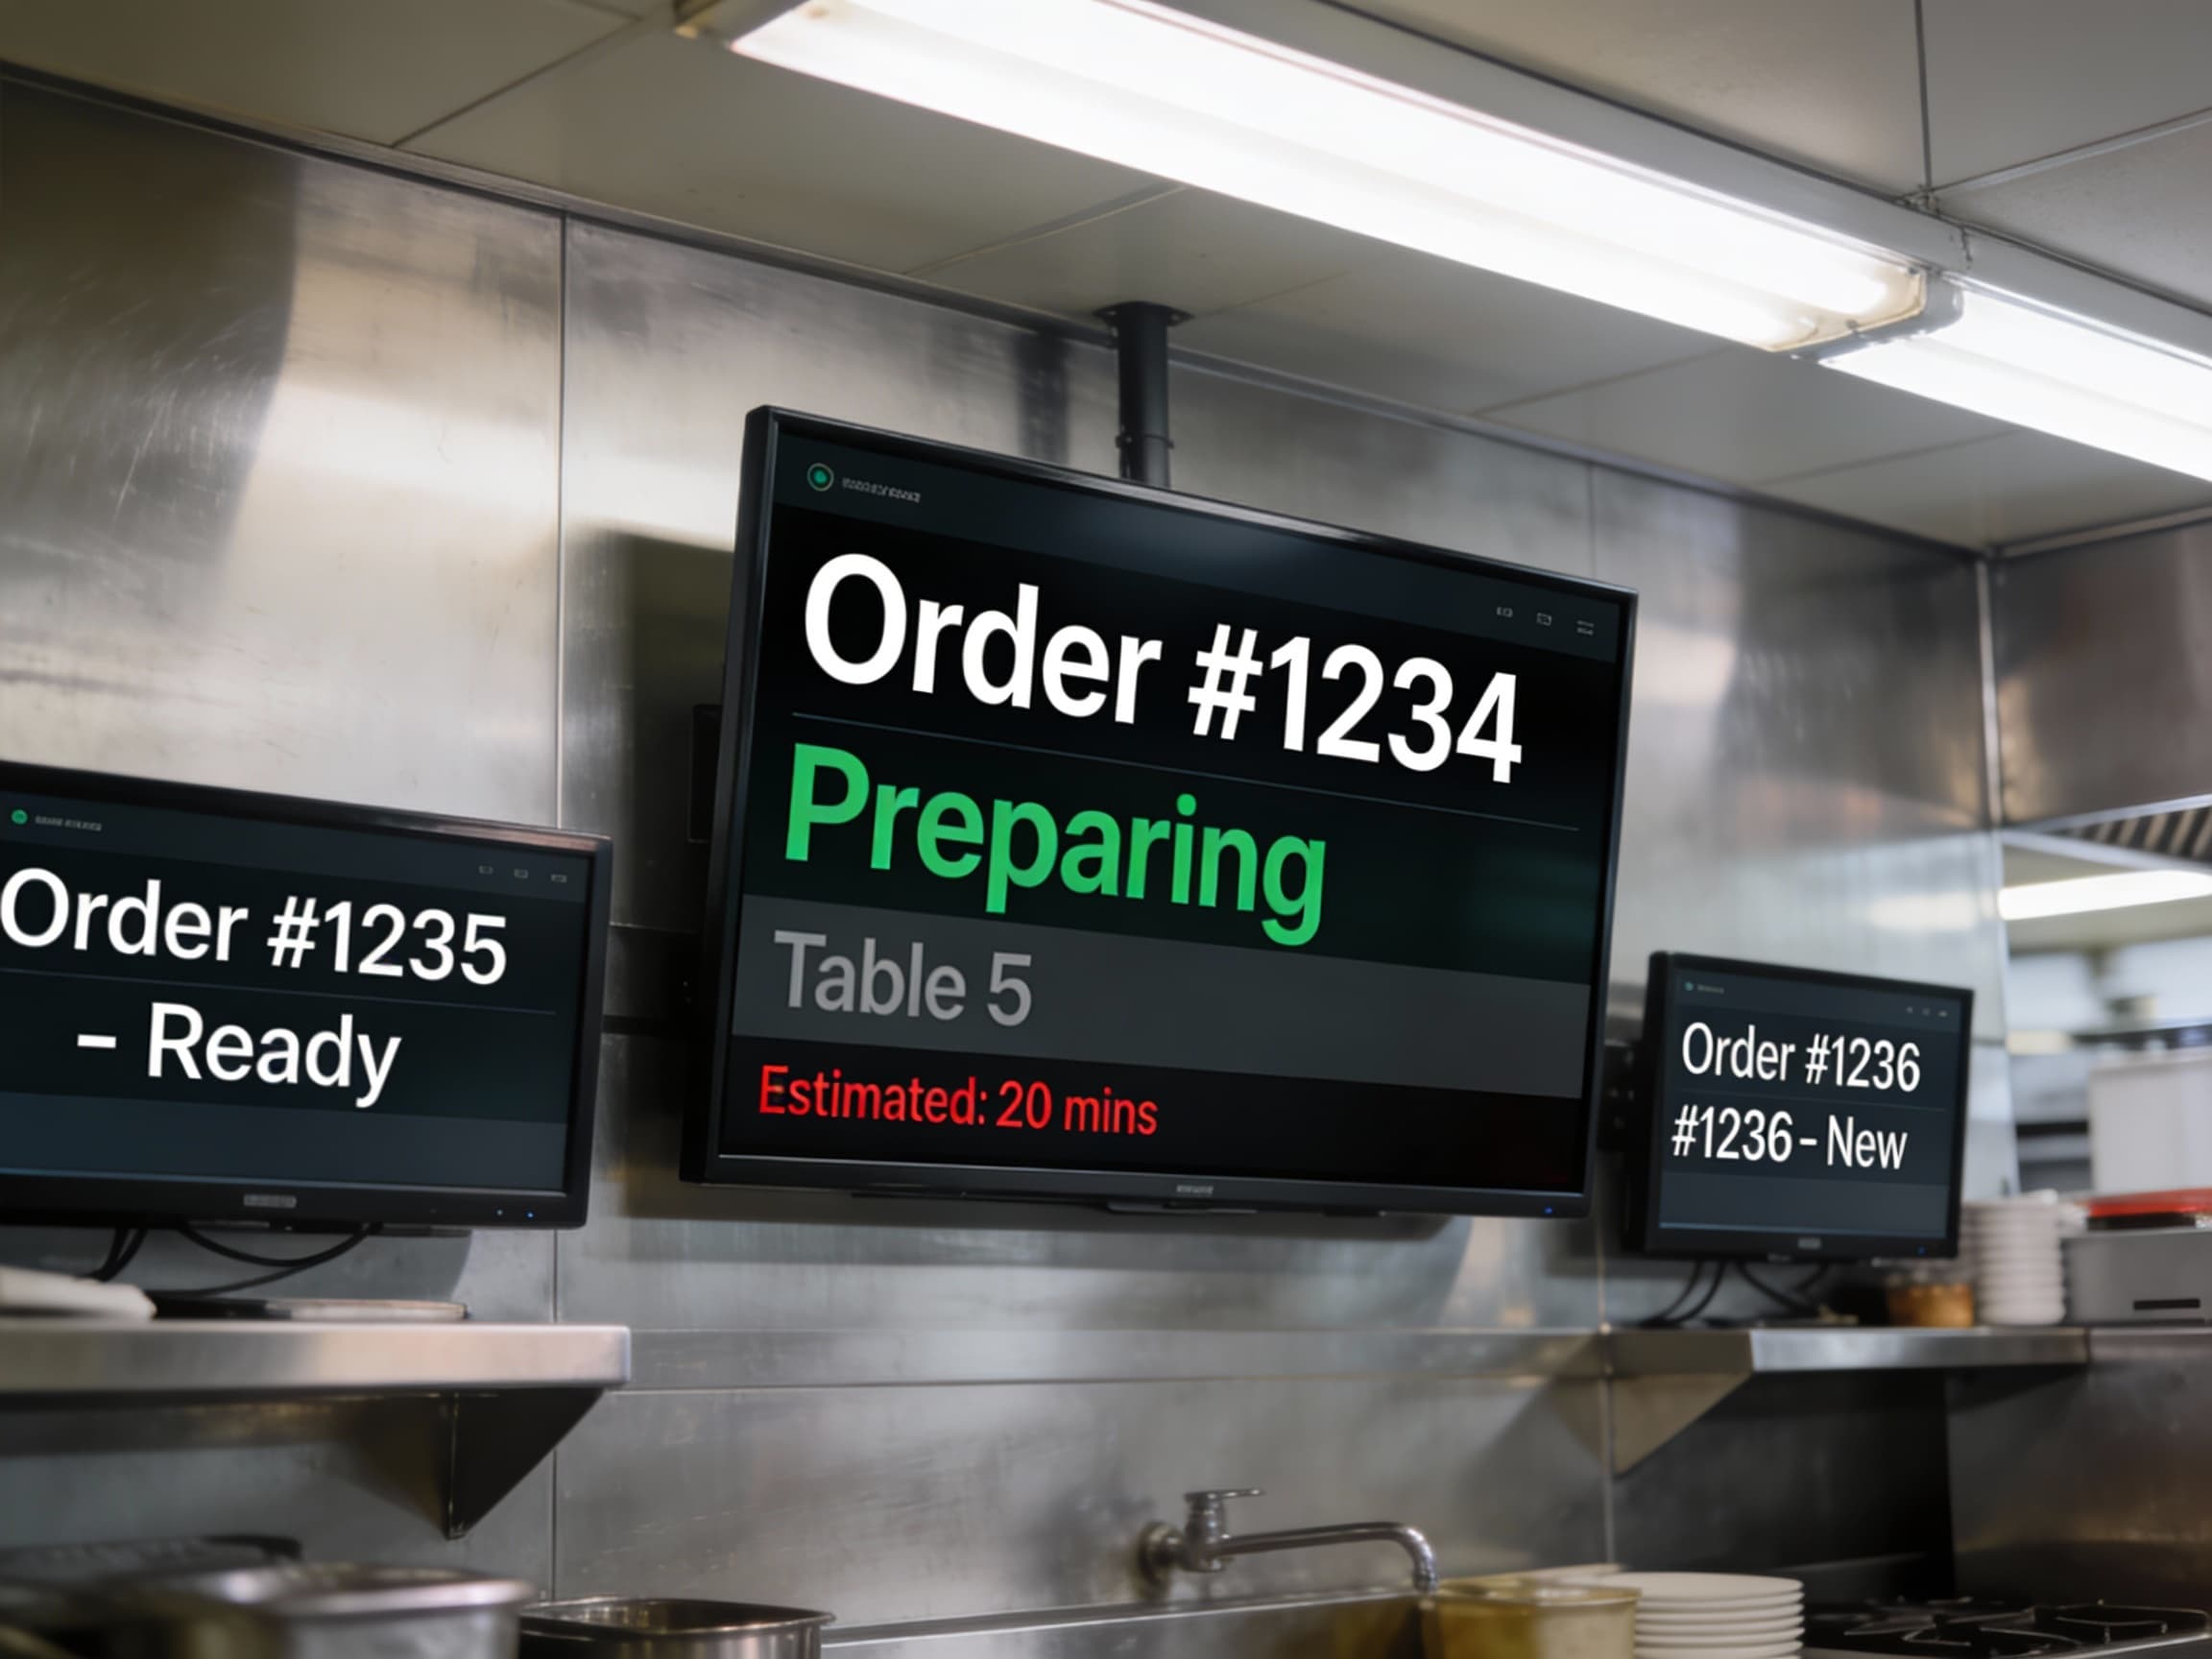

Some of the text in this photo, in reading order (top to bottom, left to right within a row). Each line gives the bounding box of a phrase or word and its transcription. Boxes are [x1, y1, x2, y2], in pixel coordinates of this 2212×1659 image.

[804, 552, 1524, 784] Order #1234
[784, 741, 1327, 948] Preparing
[0, 866, 509, 986] Order #1235
[773, 928, 1033, 1027] Table 5
[147, 1000, 403, 1110] Ready
[758, 1063, 1159, 1137] Estimated: 20 mins
[1681, 1021, 1922, 1094] Order #1236
[1670, 1103, 1794, 1164] #1236
[1826, 1114, 1909, 1171] New
